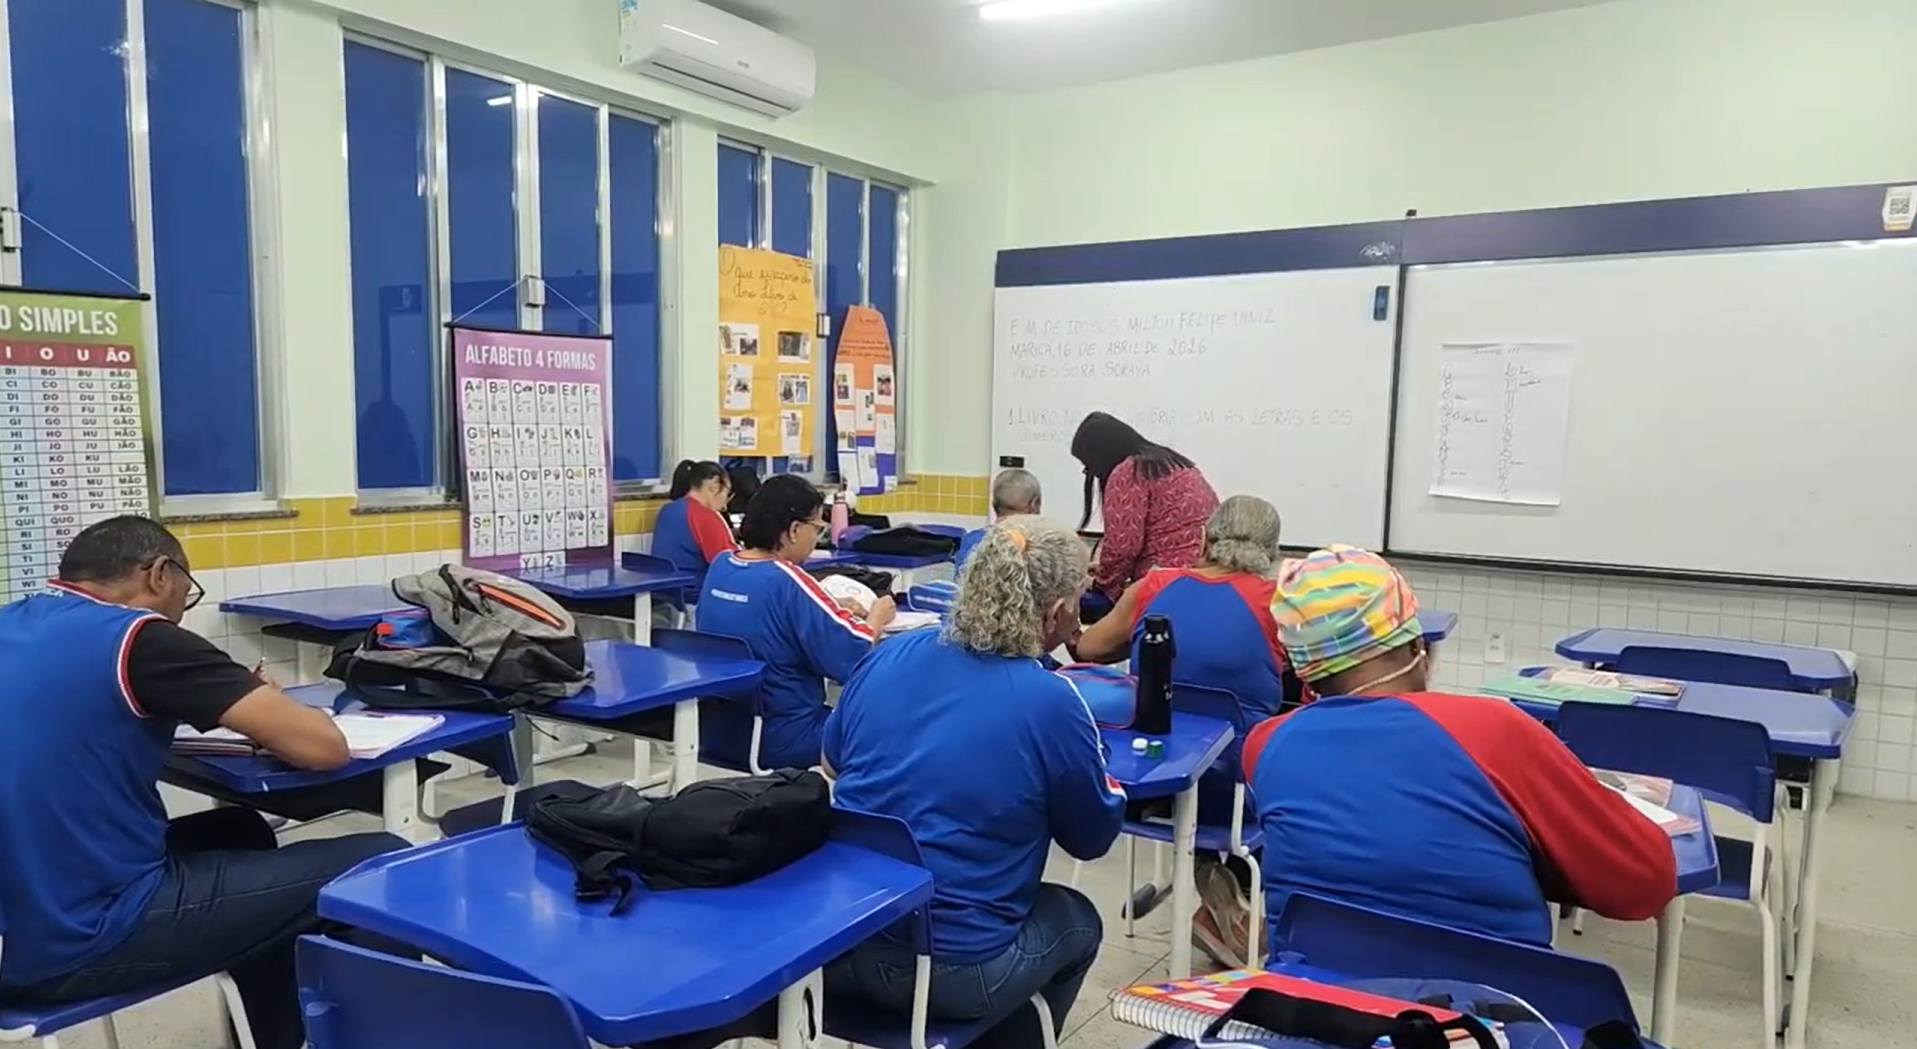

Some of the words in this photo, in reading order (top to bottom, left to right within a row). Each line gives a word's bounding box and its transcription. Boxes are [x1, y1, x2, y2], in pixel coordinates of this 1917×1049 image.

[18, 306, 118, 336] SIMPLES
[1078, 342, 1097, 357] DE
[1106, 340, 1141, 356] ABRIL
[1145, 340, 1160, 354] DE
[1166, 336, 1207, 356] 2026
[39, 347, 54, 360] O
[76, 348, 90, 362] U
[106, 347, 131, 362] ÃO
[466, 343, 532, 367] ALFABETO
[536, 350, 544, 368] 4
[547, 350, 596, 371] FORMAS
[6, 380, 18, 388] CI
[78, 382, 94, 390] CU
[110, 381, 132, 390] CÃO
[464, 380, 474, 392] A
[490, 382, 498, 394] B
[513, 382, 522, 394] C
[538, 384, 548, 395] D
[562, 384, 570, 396] E
[584, 386, 590, 396] F
[79, 394, 95, 402] DU
[111, 393, 133, 402] DÃO
[81, 406, 95, 414] FU
[113, 405, 134, 413] FÃO
[9, 418, 22, 426] GI
[45, 418, 61, 426] GO
[82, 418, 97, 426] GU
[113, 416, 136, 426] GÃO
[1224, 409, 1244, 425] AS
[1250, 409, 1304, 426] LETRAS
[1311, 410, 1320, 426] E
[10, 430, 22, 438] HI
[46, 430, 62, 438] HO
[82, 430, 98, 438] HU
[468, 427, 478, 439] G
[492, 428, 500, 438] H
[541, 429, 548, 439] J
[564, 428, 572, 438] K
[586, 428, 592, 438] L
[86, 442, 98, 450] JU
[13, 456, 24, 464] KI
[48, 455, 64, 463] KO
[85, 454, 100, 462] KU
[14, 468, 25, 476] LI
[50, 467, 65, 475] LO
[87, 466, 100, 474] LU
[118, 464, 139, 472] LÃO
[470, 471, 480, 482] M
[496, 471, 504, 482] N
[520, 470, 530, 480] O
[544, 470, 552, 480] P
[566, 468, 574, 480] Q
[588, 468, 596, 478] R
[86, 478, 103, 486] MU
[118, 476, 142, 484] MÃO
[52, 492, 68, 500] NO
[88, 490, 104, 498] NU
[120, 488, 142, 496] NÃO
[18, 506, 30, 514] PI
[53, 504, 69, 512] PO
[90, 502, 104, 510] PU
[122, 499, 142, 508] PÃO
[14, 518, 35, 527] QUI
[50, 516, 74, 524] QUO
[472, 516, 482, 528] S
[498, 516, 505, 526] T
[522, 514, 531, 526] U
[546, 512, 554, 523] V
[568, 511, 577, 521] W
[590, 510, 597, 520] X
[56, 528, 70, 536] RO
[22, 543, 32, 551] SI
[522, 558, 530, 567] Y
[546, 556, 553, 567] Z
[22, 568, 34, 576] VI
[22, 580, 36, 588] WI
